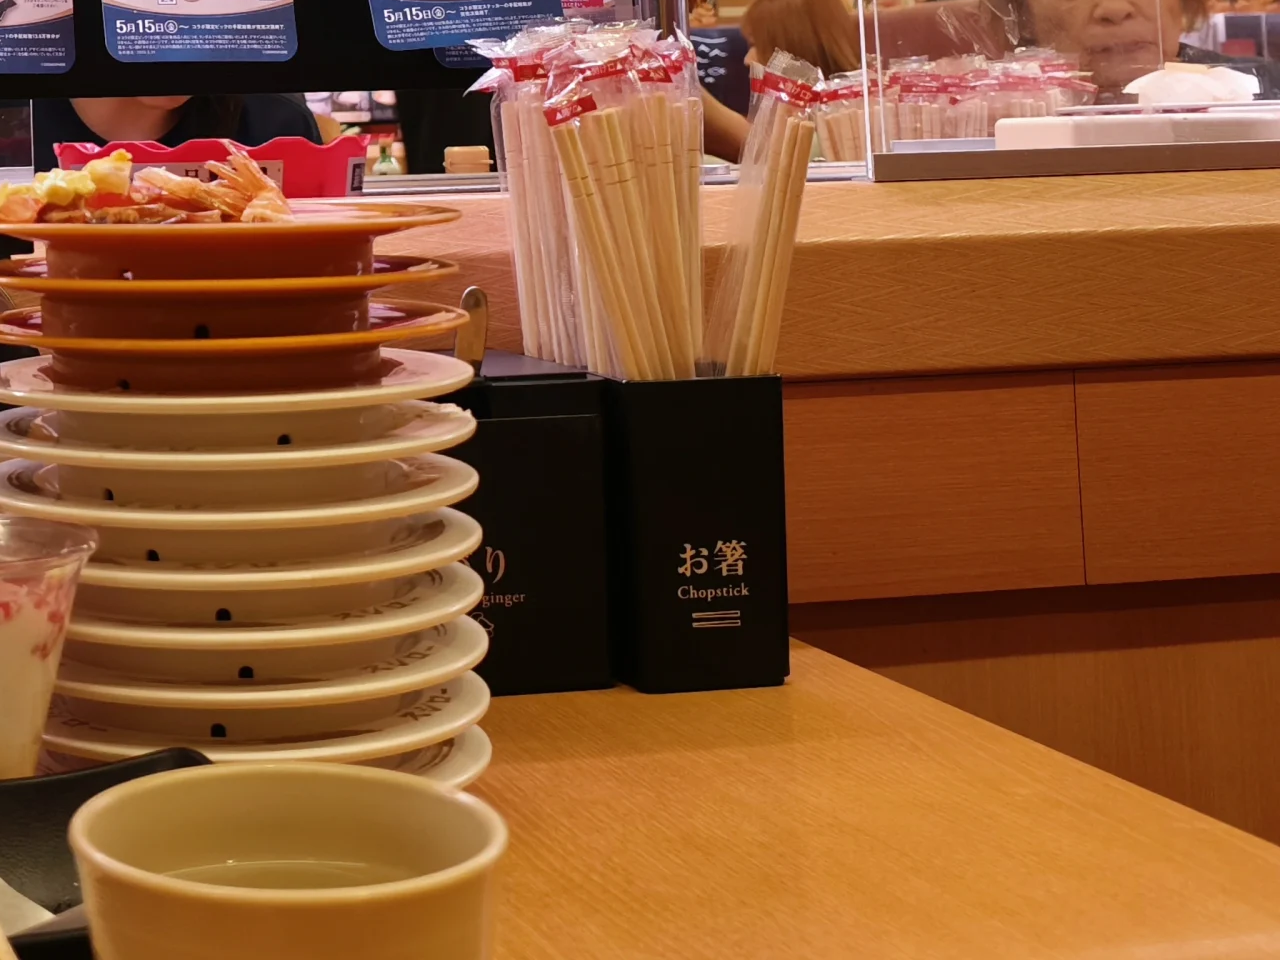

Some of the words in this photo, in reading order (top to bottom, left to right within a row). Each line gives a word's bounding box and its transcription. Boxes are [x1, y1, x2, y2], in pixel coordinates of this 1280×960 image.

[677, 540, 748, 578] お箸
[482, 591, 526, 608] ginger
[677, 583, 750, 601] Chopstick
